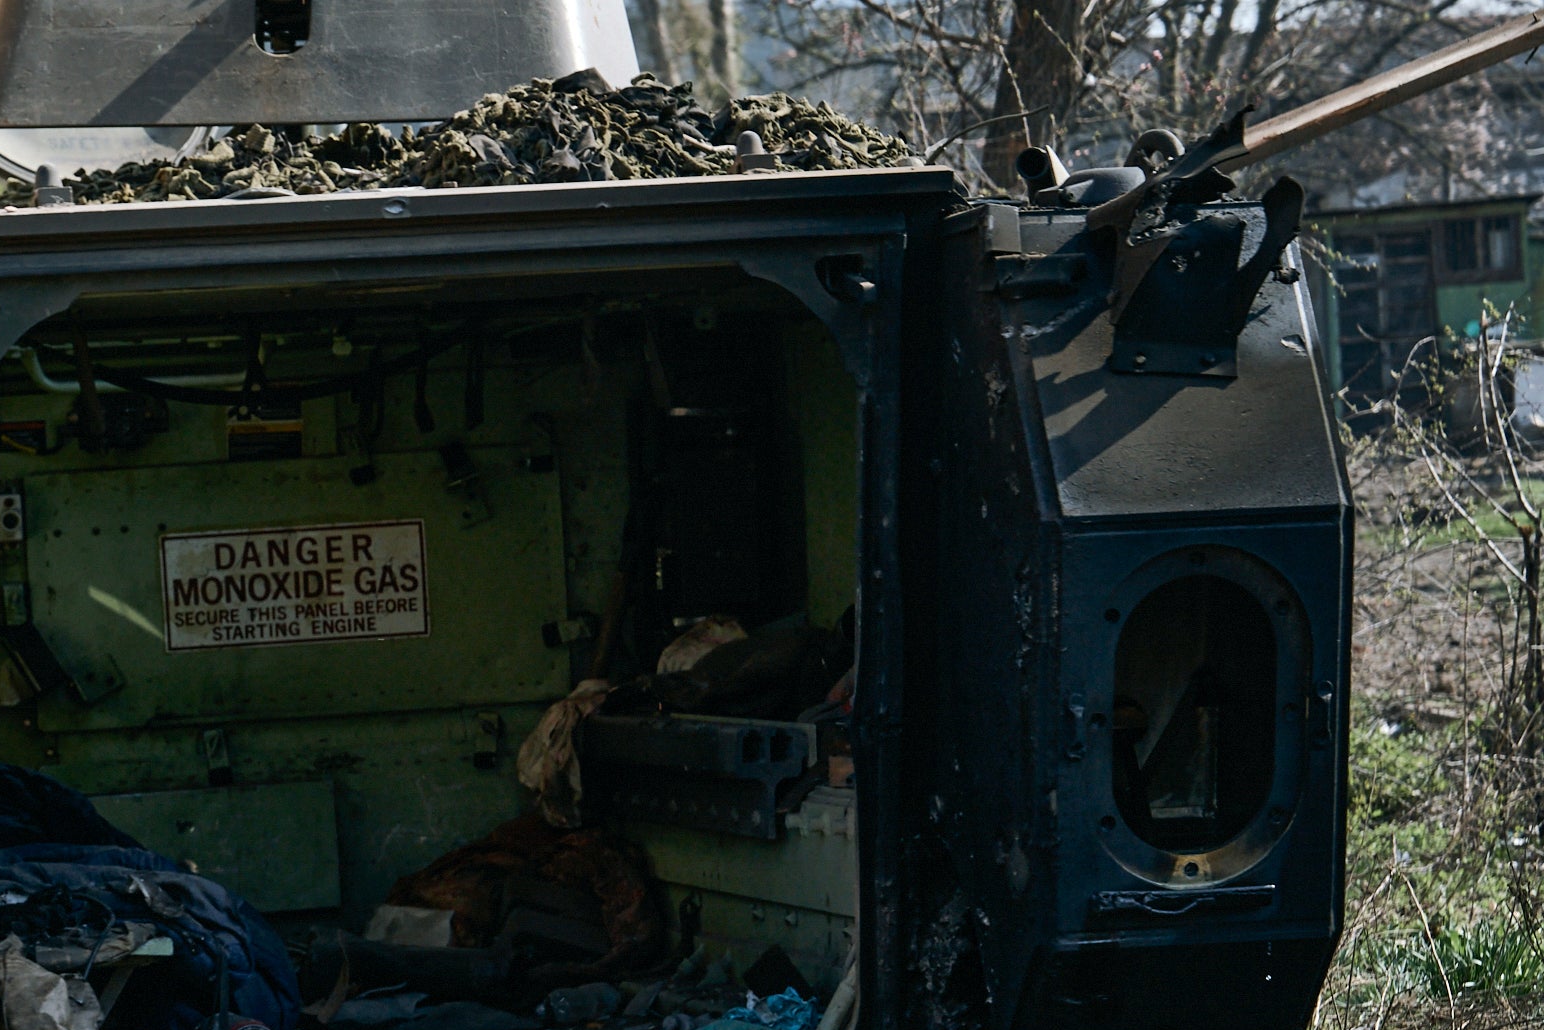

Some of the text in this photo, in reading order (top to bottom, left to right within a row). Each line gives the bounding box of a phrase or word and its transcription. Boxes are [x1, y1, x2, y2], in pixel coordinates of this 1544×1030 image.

[214, 534, 373, 570] DANGER
[172, 564, 418, 606] MONOXIDE GAS
[174, 598, 418, 627] SECURE THIS PANEL BEFORE
[212, 617, 376, 641] STARTING ENGINE
